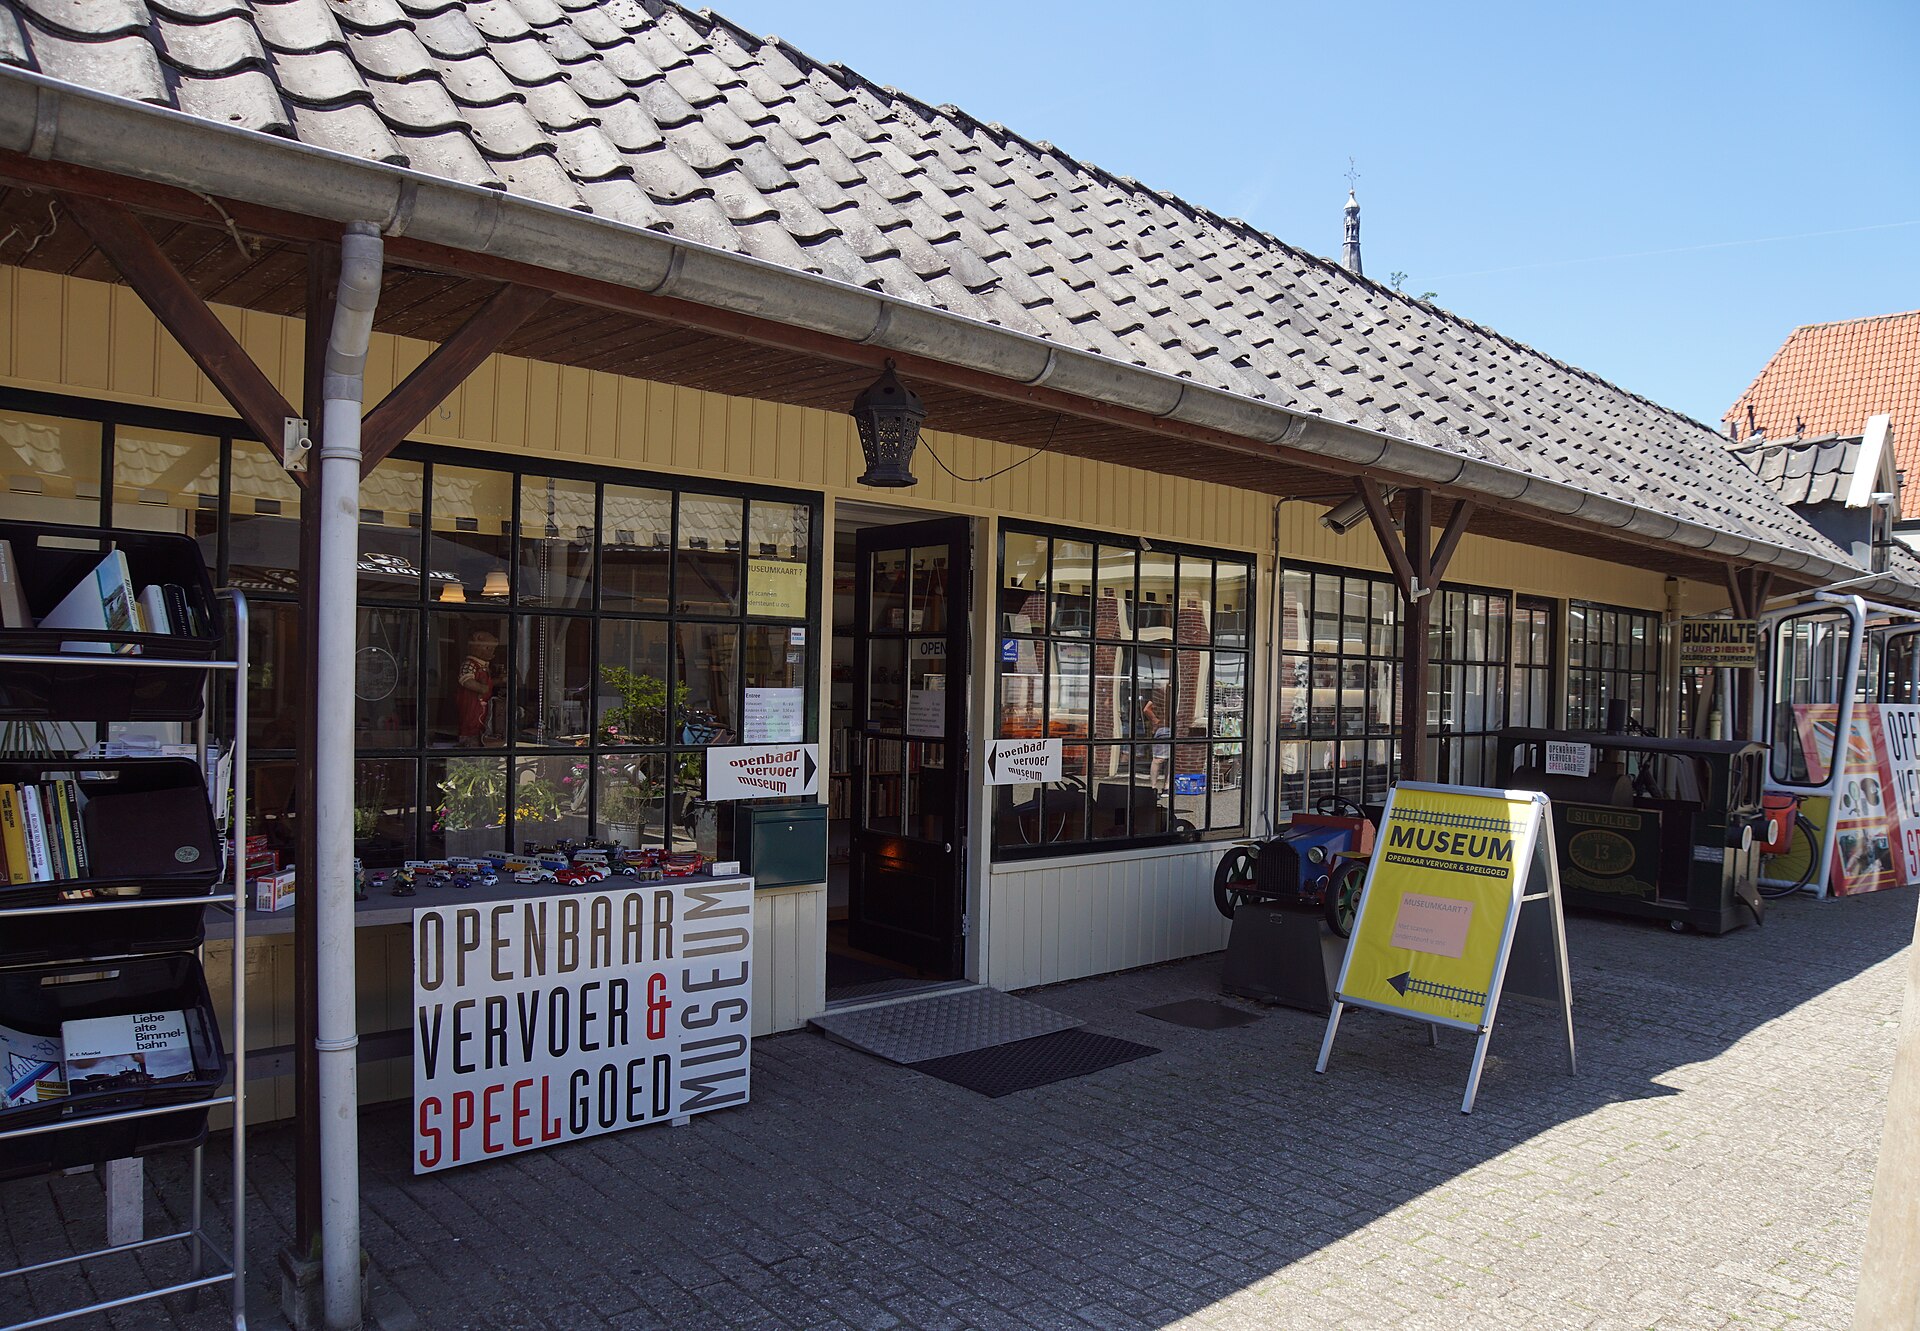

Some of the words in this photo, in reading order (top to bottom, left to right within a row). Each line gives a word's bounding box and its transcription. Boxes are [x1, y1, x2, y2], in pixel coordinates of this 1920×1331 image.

[1682, 623, 1756, 643] BUSHALTE
[1887, 711, 1920, 761] OPE
[998, 740, 1047, 758] openbaar
[1549, 744, 1577, 754] OPENBAAR
[729, 749, 801, 768] openbaar
[1013, 755, 1050, 766] vervoer
[1549, 753, 1572, 763] VERVOER
[746, 767, 799, 778] vervoer
[1008, 767, 1042, 781] museum
[1548, 762, 1577, 772] SPEELGOED
[737, 776, 787, 794] museum
[1575, 811, 1631, 827] SILVOLDE
[1389, 825, 1516, 862] MUSEUM
[1594, 844, 1610, 860] 13
[1387, 854, 1424, 865] OPENBAAR
[1425, 858, 1458, 870] VERVOER
[1465, 865, 1507, 877] SPEELGOED
[1404, 898, 1463, 913] MUSEUMKAART
[419, 889, 674, 991] OPENBAAR
[680, 882, 750, 1113] MUSEUM
[133, 1014, 165, 1024] Liebe
[418, 977, 629, 1081] VERVOER
[646, 972, 672, 1041] &
[134, 1023, 157, 1033] alte
[135, 1029, 185, 1041] Bimmel-
[136, 1041, 168, 1050] bahn
[3, 1054, 42, 1082] Halte
[419, 1053, 671, 1168] SPEELGOED
